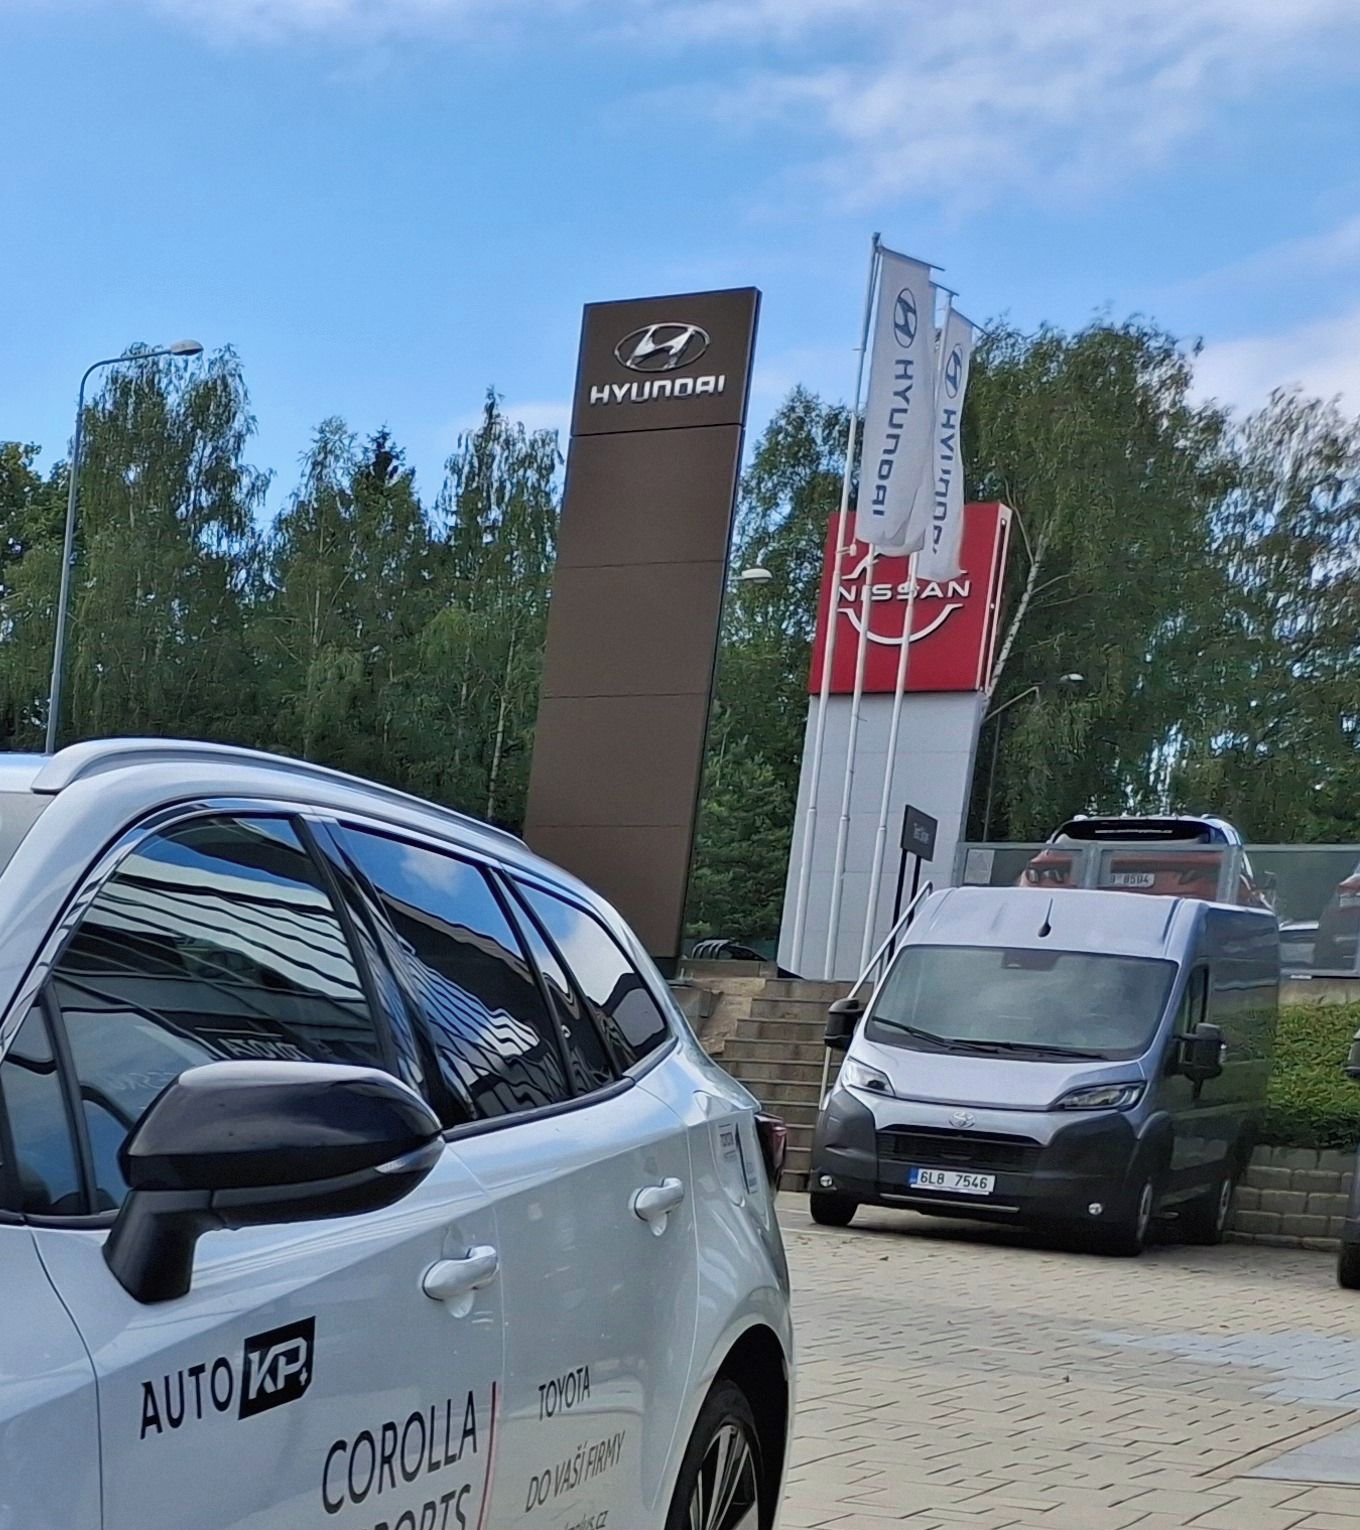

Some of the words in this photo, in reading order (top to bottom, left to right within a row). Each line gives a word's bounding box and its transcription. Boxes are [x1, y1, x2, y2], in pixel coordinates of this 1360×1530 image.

[589, 374, 726, 405] HYUNDAI
[872, 359, 914, 518] HYUNDAI
[932, 408, 958, 555] HYNDA
[838, 580, 971, 602] NISSAN
[920, 1171, 945, 1185] 6L8
[955, 1174, 988, 1189] 7546
[140, 1356, 233, 1440] AUTO
[537, 1365, 591, 1421] TOYOTA
[322, 1390, 477, 1514] COROLLA
[525, 1469, 552, 1513] DO
[553, 1440, 588, 1498] VAŠÍ
[584, 1430, 626, 1481] FIRMY
